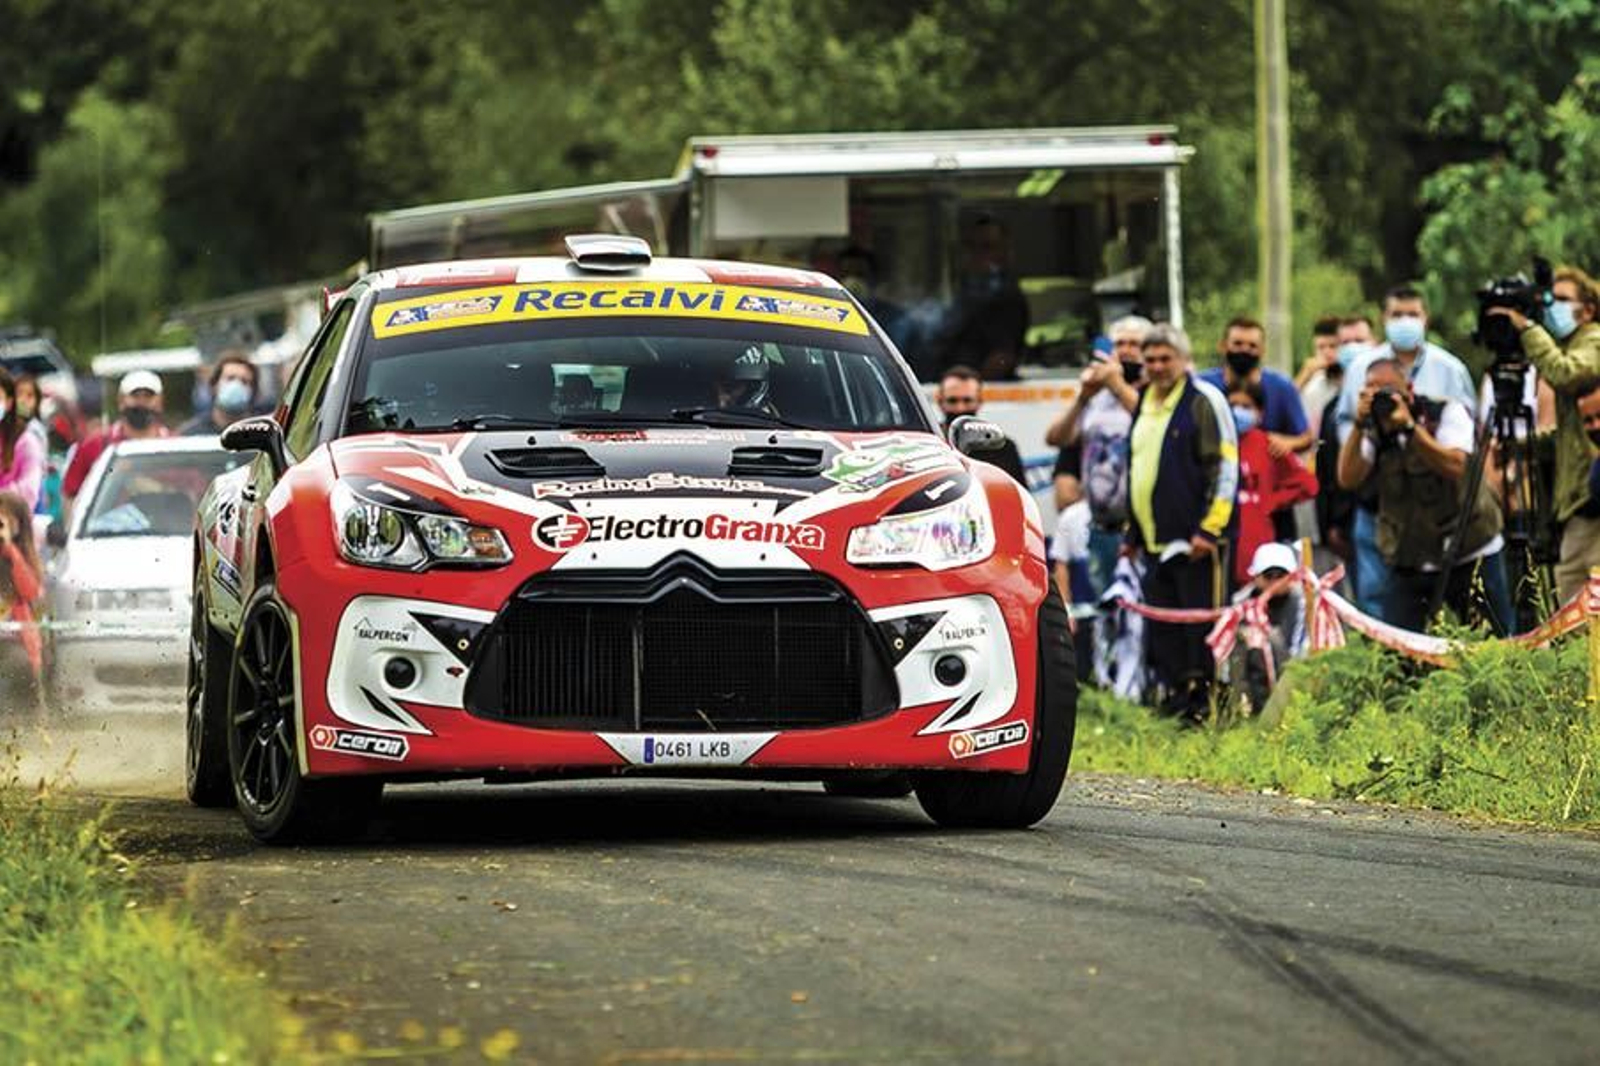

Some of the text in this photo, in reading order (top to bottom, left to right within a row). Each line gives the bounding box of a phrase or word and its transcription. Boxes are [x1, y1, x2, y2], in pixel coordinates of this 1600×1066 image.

[513, 288, 725, 312] Recalvi
[585, 514, 822, 548] ElectroGranxa
[655, 742, 731, 757] 0461 LKB
